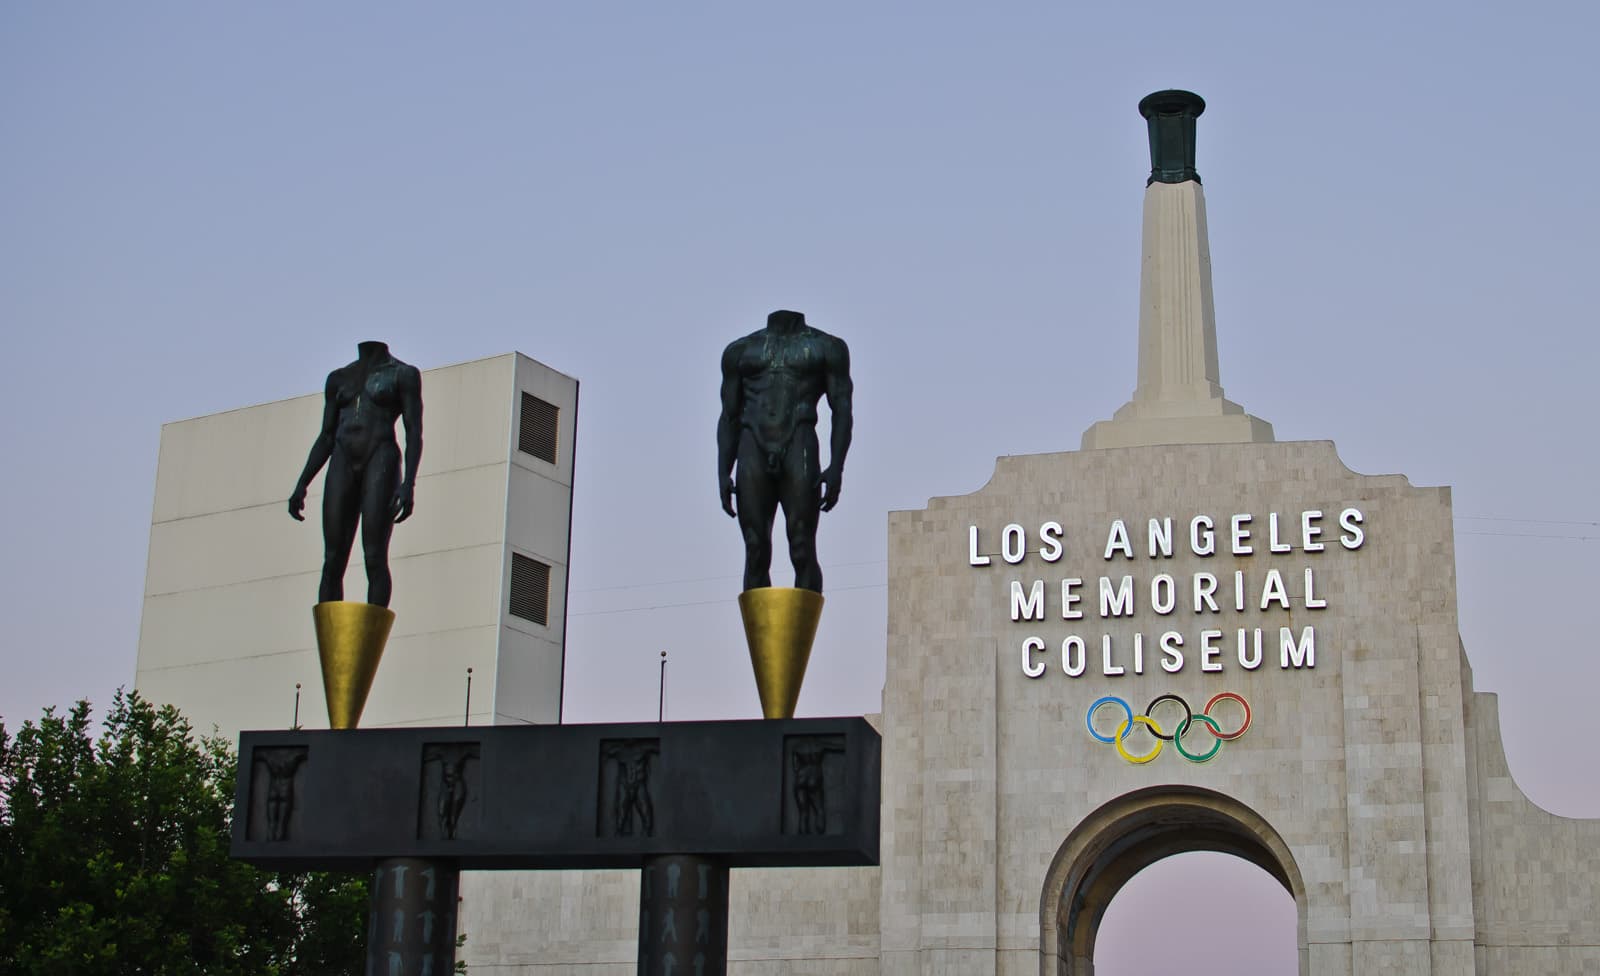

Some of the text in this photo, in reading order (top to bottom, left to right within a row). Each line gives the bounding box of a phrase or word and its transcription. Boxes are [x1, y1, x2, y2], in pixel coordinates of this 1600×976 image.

[969, 508, 1365, 566] LOS ANGELES
[1010, 568, 1327, 620] MEMORIAL
[1021, 626, 1315, 678] COLISEUM
